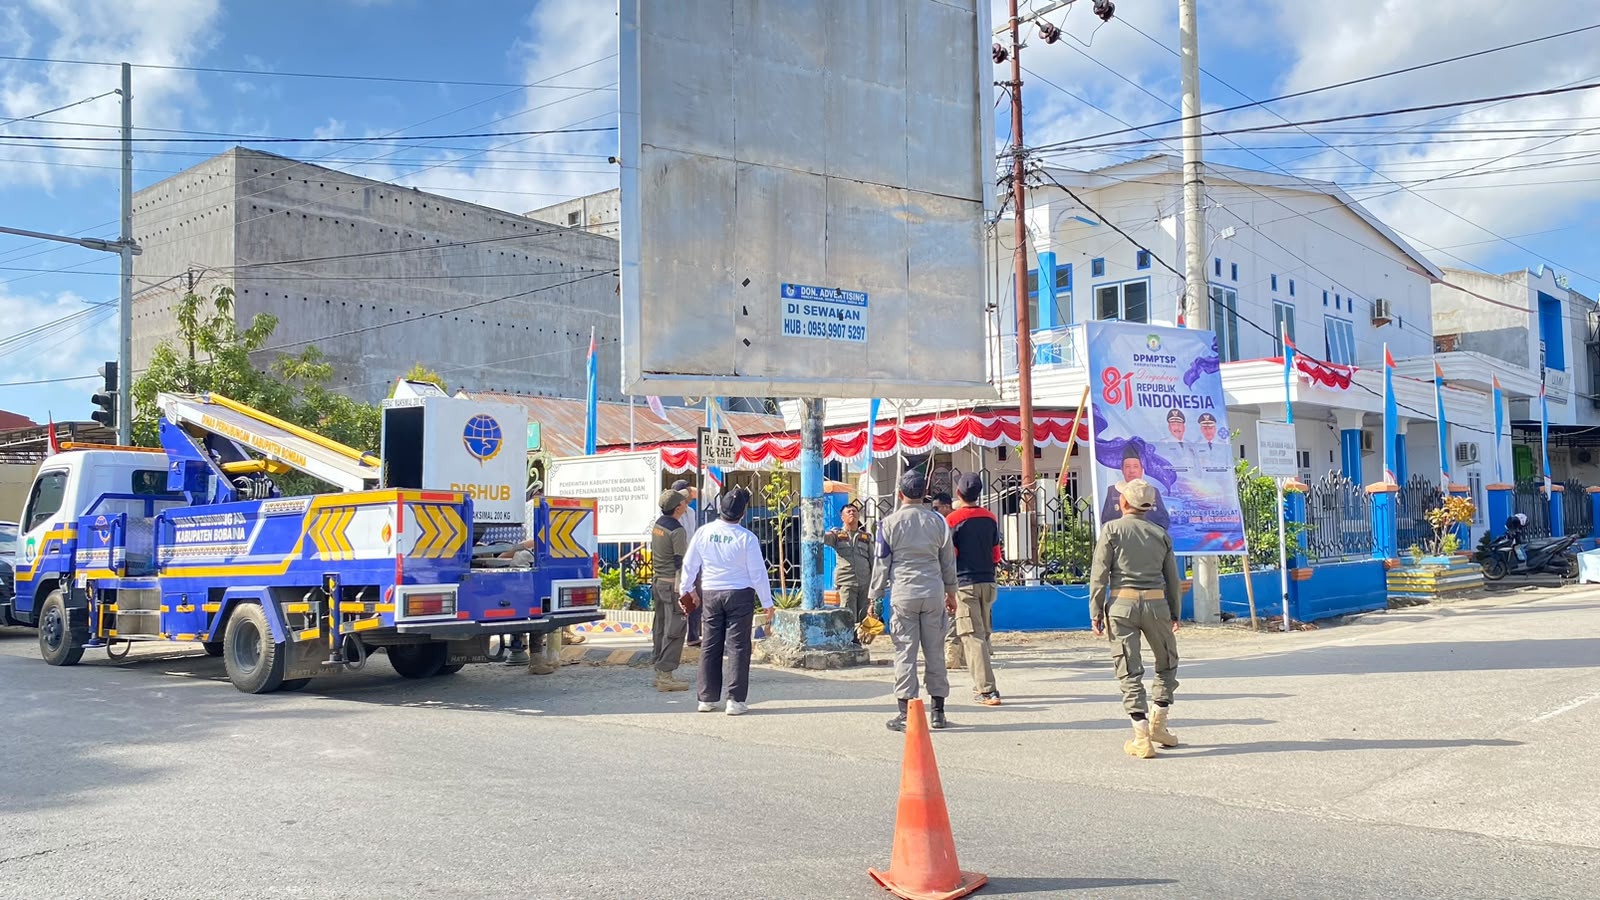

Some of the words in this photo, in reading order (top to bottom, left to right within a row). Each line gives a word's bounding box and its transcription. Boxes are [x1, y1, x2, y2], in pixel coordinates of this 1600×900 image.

[800, 287, 818, 297] DON.
[788, 303, 799, 314] DI
[803, 305, 860, 321] SEWAKAN
[784, 318, 801, 334] HUB
[828, 322, 846, 338] 9907
[848, 325, 866, 341] 5297
[1133, 353, 1176, 364] DPMPTSP
[1101, 366, 1135, 411] 81
[1136, 383, 1176, 393] REPUBLIK
[1138, 393, 1215, 409] INDONESIA
[704, 434, 734, 447] HTEL
[576, 487, 611, 495] PENANAMAN
[630, 493, 649, 501] PINTU
[598, 503, 624, 515] PTSP)
[472, 511, 493, 520] AKSIMAL
[494, 511, 503, 520] 200
[503, 511, 511, 520] KG
[175, 529, 213, 543] KABUPATEN
